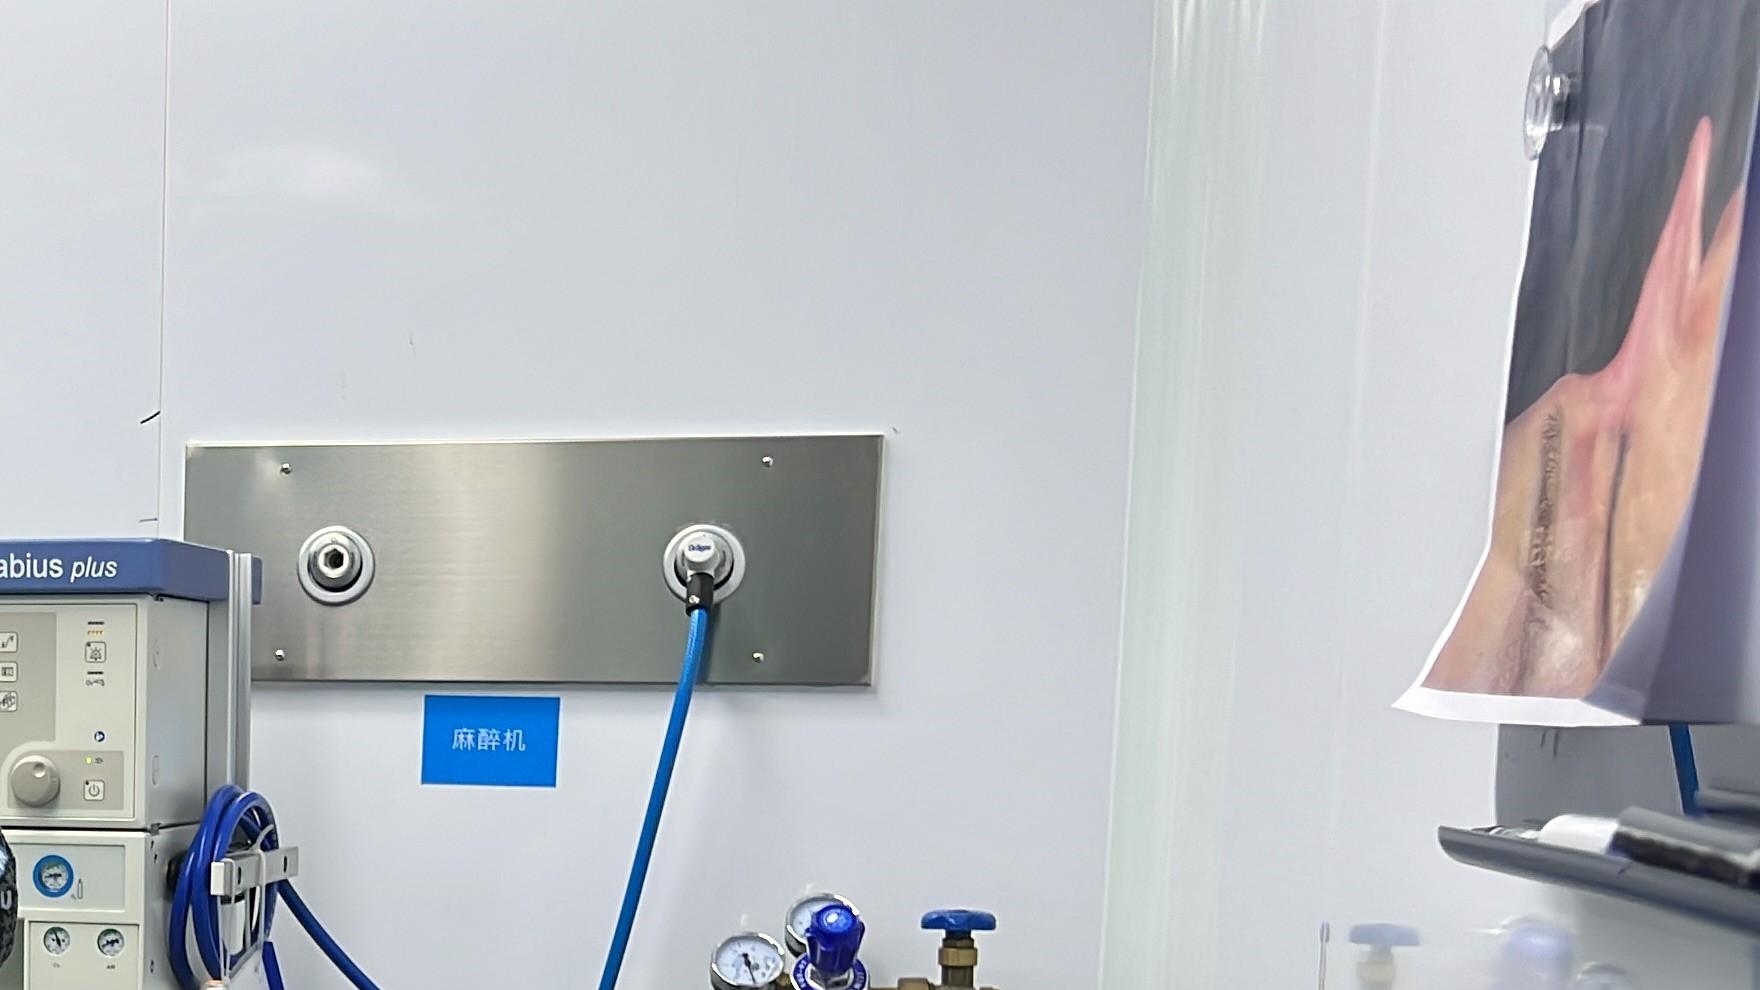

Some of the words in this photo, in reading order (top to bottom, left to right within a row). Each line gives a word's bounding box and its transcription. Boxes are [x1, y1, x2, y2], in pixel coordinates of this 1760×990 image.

[70, 556, 118, 583] plus
[452, 728, 526, 752] 麻醉机
